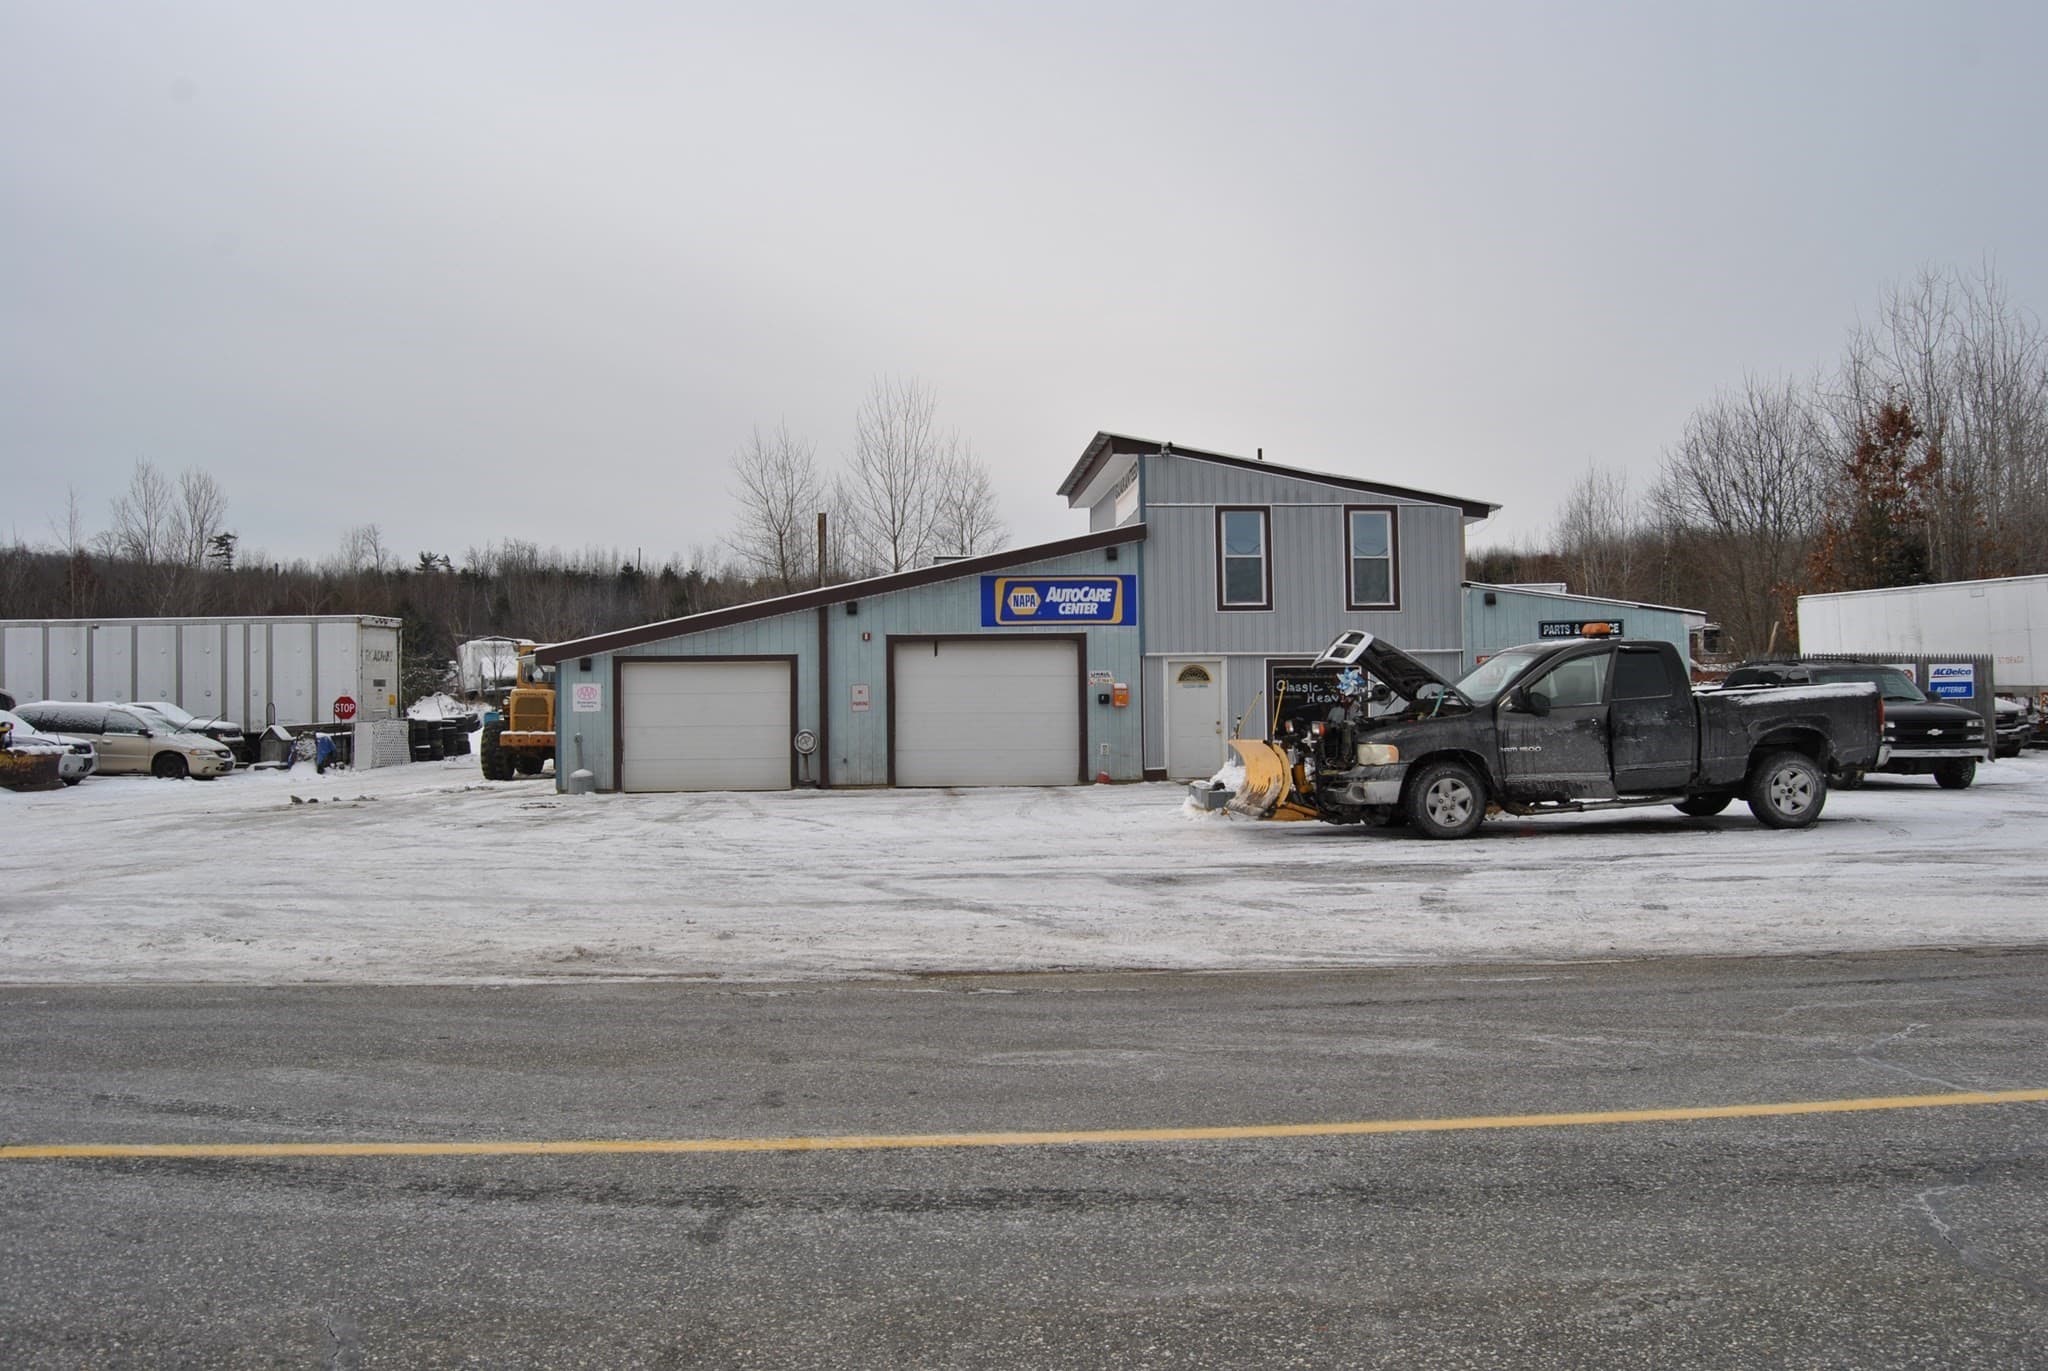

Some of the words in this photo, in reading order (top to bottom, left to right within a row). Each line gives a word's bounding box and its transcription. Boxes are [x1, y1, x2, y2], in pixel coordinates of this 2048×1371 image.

[1012, 594, 1036, 608] NAPA
[1058, 602, 1098, 615] CENTER
[1543, 624, 1570, 635] PARTS
[1574, 625, 1581, 634] &
[1933, 668, 1971, 676] ACDelco
[1936, 686, 1968, 694] BATTERIES
[335, 703, 355, 713] STOP
